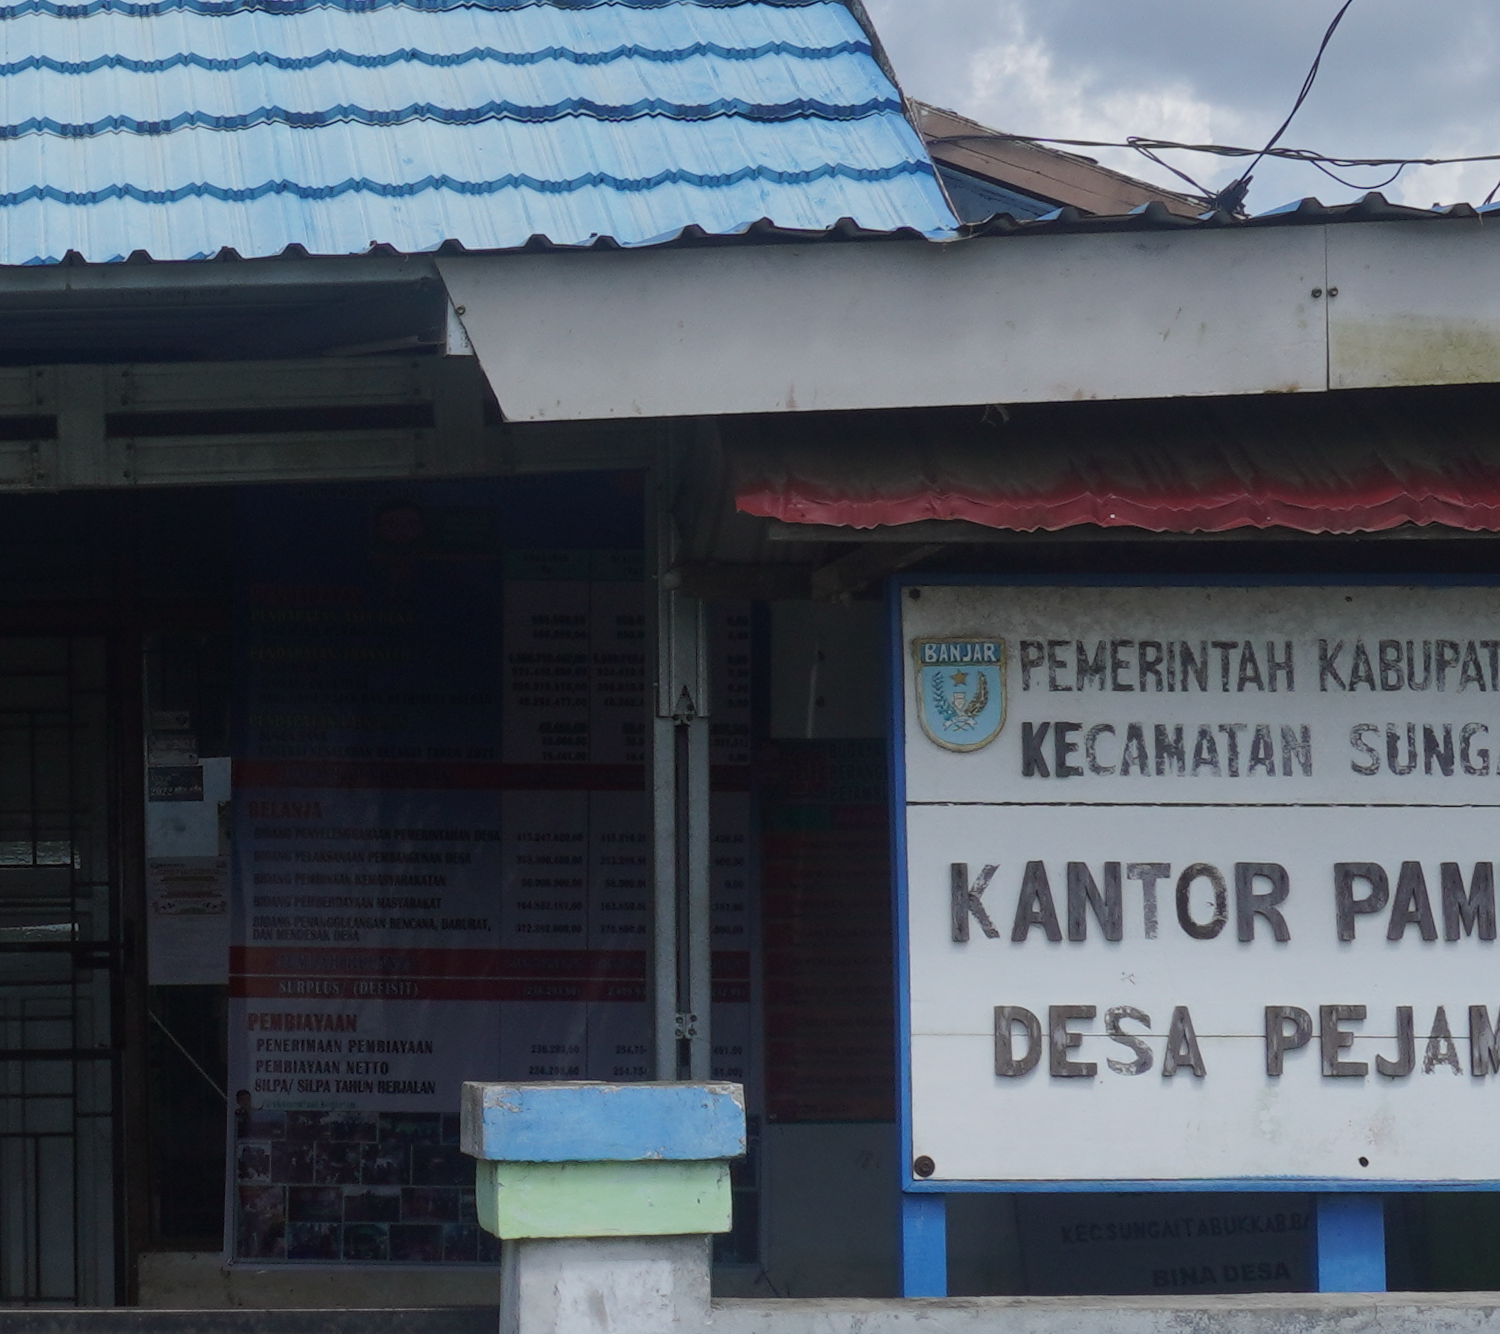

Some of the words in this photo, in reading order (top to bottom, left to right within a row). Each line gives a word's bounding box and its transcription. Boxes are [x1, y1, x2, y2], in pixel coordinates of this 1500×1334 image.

[924, 643, 996, 664] BANJAR
[1021, 638, 1294, 694] PEMERINTAH
[1021, 721, 1313, 780] KECAMATAN
[249, 800, 323, 819] BELANJA
[394, 829, 470, 842] PEMERINTAHAN
[368, 852, 442, 864] PEMBANGUNAN
[445, 852, 472, 865] DESA
[253, 873, 291, 885] BIDANG
[354, 873, 446, 886] KEMASYARAKATAN
[253, 896, 291, 908] BIDANG
[294, 896, 373, 908] PEMBERDAYAAN
[377, 897, 442, 909] MASYARAKAT
[949, 860, 1291, 943] KANTOR
[253, 916, 291, 928] BIDANG
[294, 916, 386, 929] PENANGGULANGAN
[390, 917, 438, 931] BENCANA,
[442, 918, 491, 932] DARURAT,
[253, 929, 273, 940] DAN
[276, 929, 330, 941] MENDESAK
[333, 929, 360, 941] DESA
[353, 981, 419, 998] (DEFISIT)
[248, 1013, 357, 1033] PEMBIAYAAN
[256, 1038, 342, 1053] PENERIMAAN
[348, 1039, 433, 1055] PEMBIAYAAN
[993, 1003, 1207, 1079] DESA
[256, 1060, 340, 1074] PEMBIAYAAN
[346, 1061, 389, 1075] NETTO
[335, 1079, 373, 1094] TAHUN
[377, 1080, 436, 1095] BERJALAN
